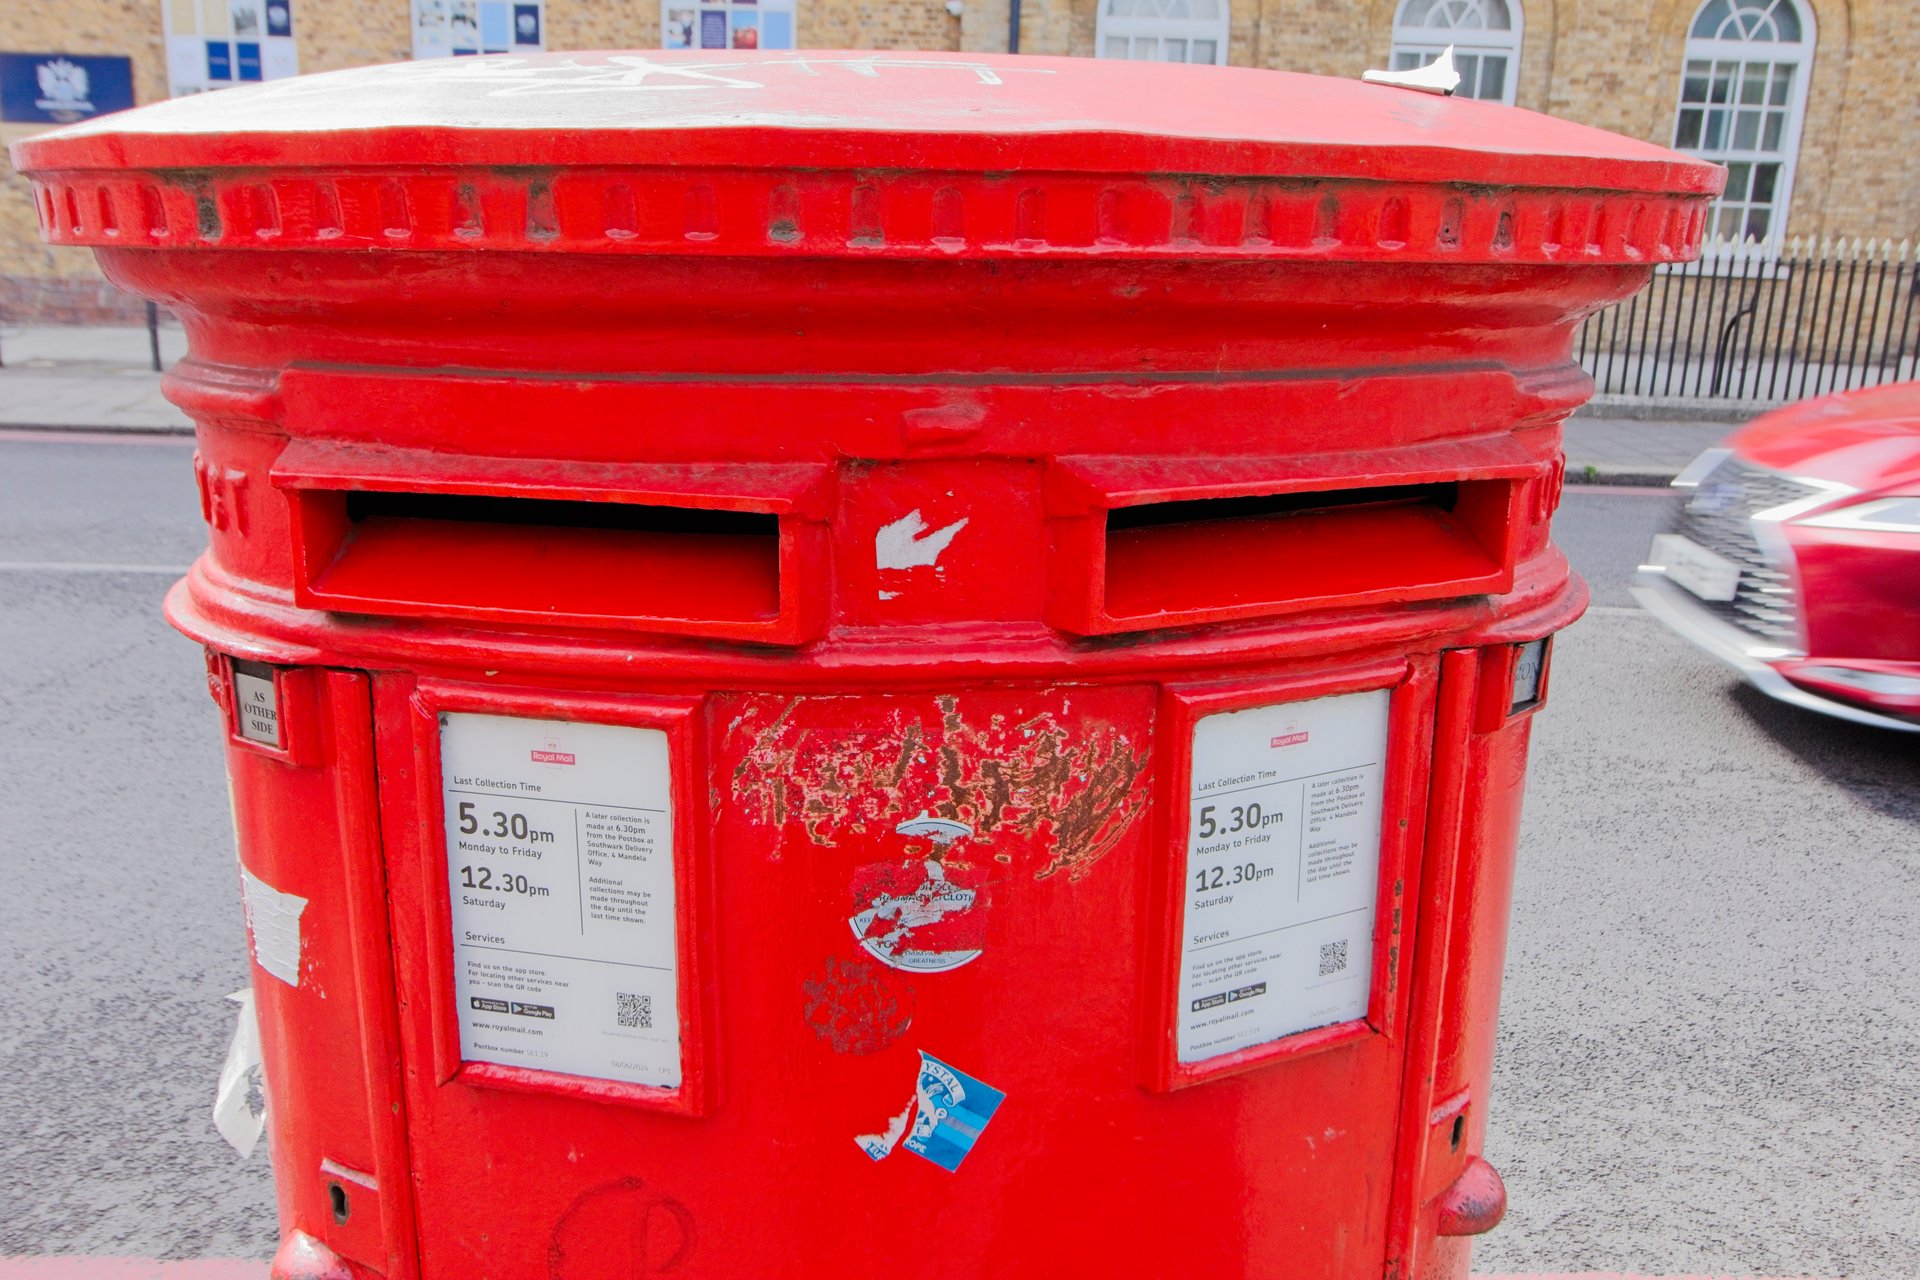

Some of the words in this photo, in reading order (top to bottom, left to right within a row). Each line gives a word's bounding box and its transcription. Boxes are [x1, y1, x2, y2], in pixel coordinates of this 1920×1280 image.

[253, 691, 266, 703] AS
[244, 703, 277, 721] OTHER
[251, 719, 274, 735] SIDE
[1272, 736, 1292, 747] Royal
[1292, 732, 1308, 743] Mail
[533, 751, 555, 762] Royal
[556, 753, 574, 763] Mail
[453, 775, 472, 785] Last
[474, 777, 517, 789] Collection
[519, 781, 541, 792] Time
[1198, 781, 1215, 791] Last
[1217, 774, 1255, 787] Collection
[1257, 770, 1277, 779] Time
[459, 801, 554, 844] 5.30pm
[591, 812, 608, 820] later
[609, 814, 642, 823] collection
[1198, 802, 1283, 838] 5.30pm
[586, 831, 603, 839] from
[618, 834, 645, 843] Postbox
[615, 824, 646, 835] 6.30pm
[458, 840, 496, 855] Monday
[498, 845, 509, 854] to
[512, 846, 542, 860] Friday
[586, 839, 623, 850] Southwark
[624, 843, 653, 854] Delivery
[1196, 842, 1230, 856] Monday
[1233, 840, 1242, 848] to
[1244, 833, 1271, 845] Friday
[587, 849, 609, 858] Office,
[617, 852, 646, 861] Mandela
[587, 858, 602, 867] Way
[460, 865, 549, 897] 12.30pm
[588, 876, 623, 886] Additional
[1196, 862, 1274, 892] 12.30pm
[589, 886, 625, 895] collections
[626, 890, 641, 898] may
[462, 895, 506, 910] Saturday
[603, 904, 615, 913] day
[610, 896, 648, 907] throughout
[1194, 895, 1233, 910] Saturday
[590, 911, 603, 919] last
[605, 913, 621, 921] time
[465, 930, 505, 944] Services
[1193, 930, 1229, 944] Services
[467, 960, 481, 968] Find
[514, 967, 527, 975] app
[467, 968, 479, 976] For
[480, 970, 506, 981] locating
[526, 977, 553, 985] services
[523, 1008, 542, 1017] Google
[541, 1009, 553, 1018] Play
[1190, 1008, 1254, 1030] www.royalmail.com
[471, 1021, 543, 1036] www.royalmail.com
[473, 1041, 498, 1051] Postbox
[924, 1062, 959, 1093] YSTAL
